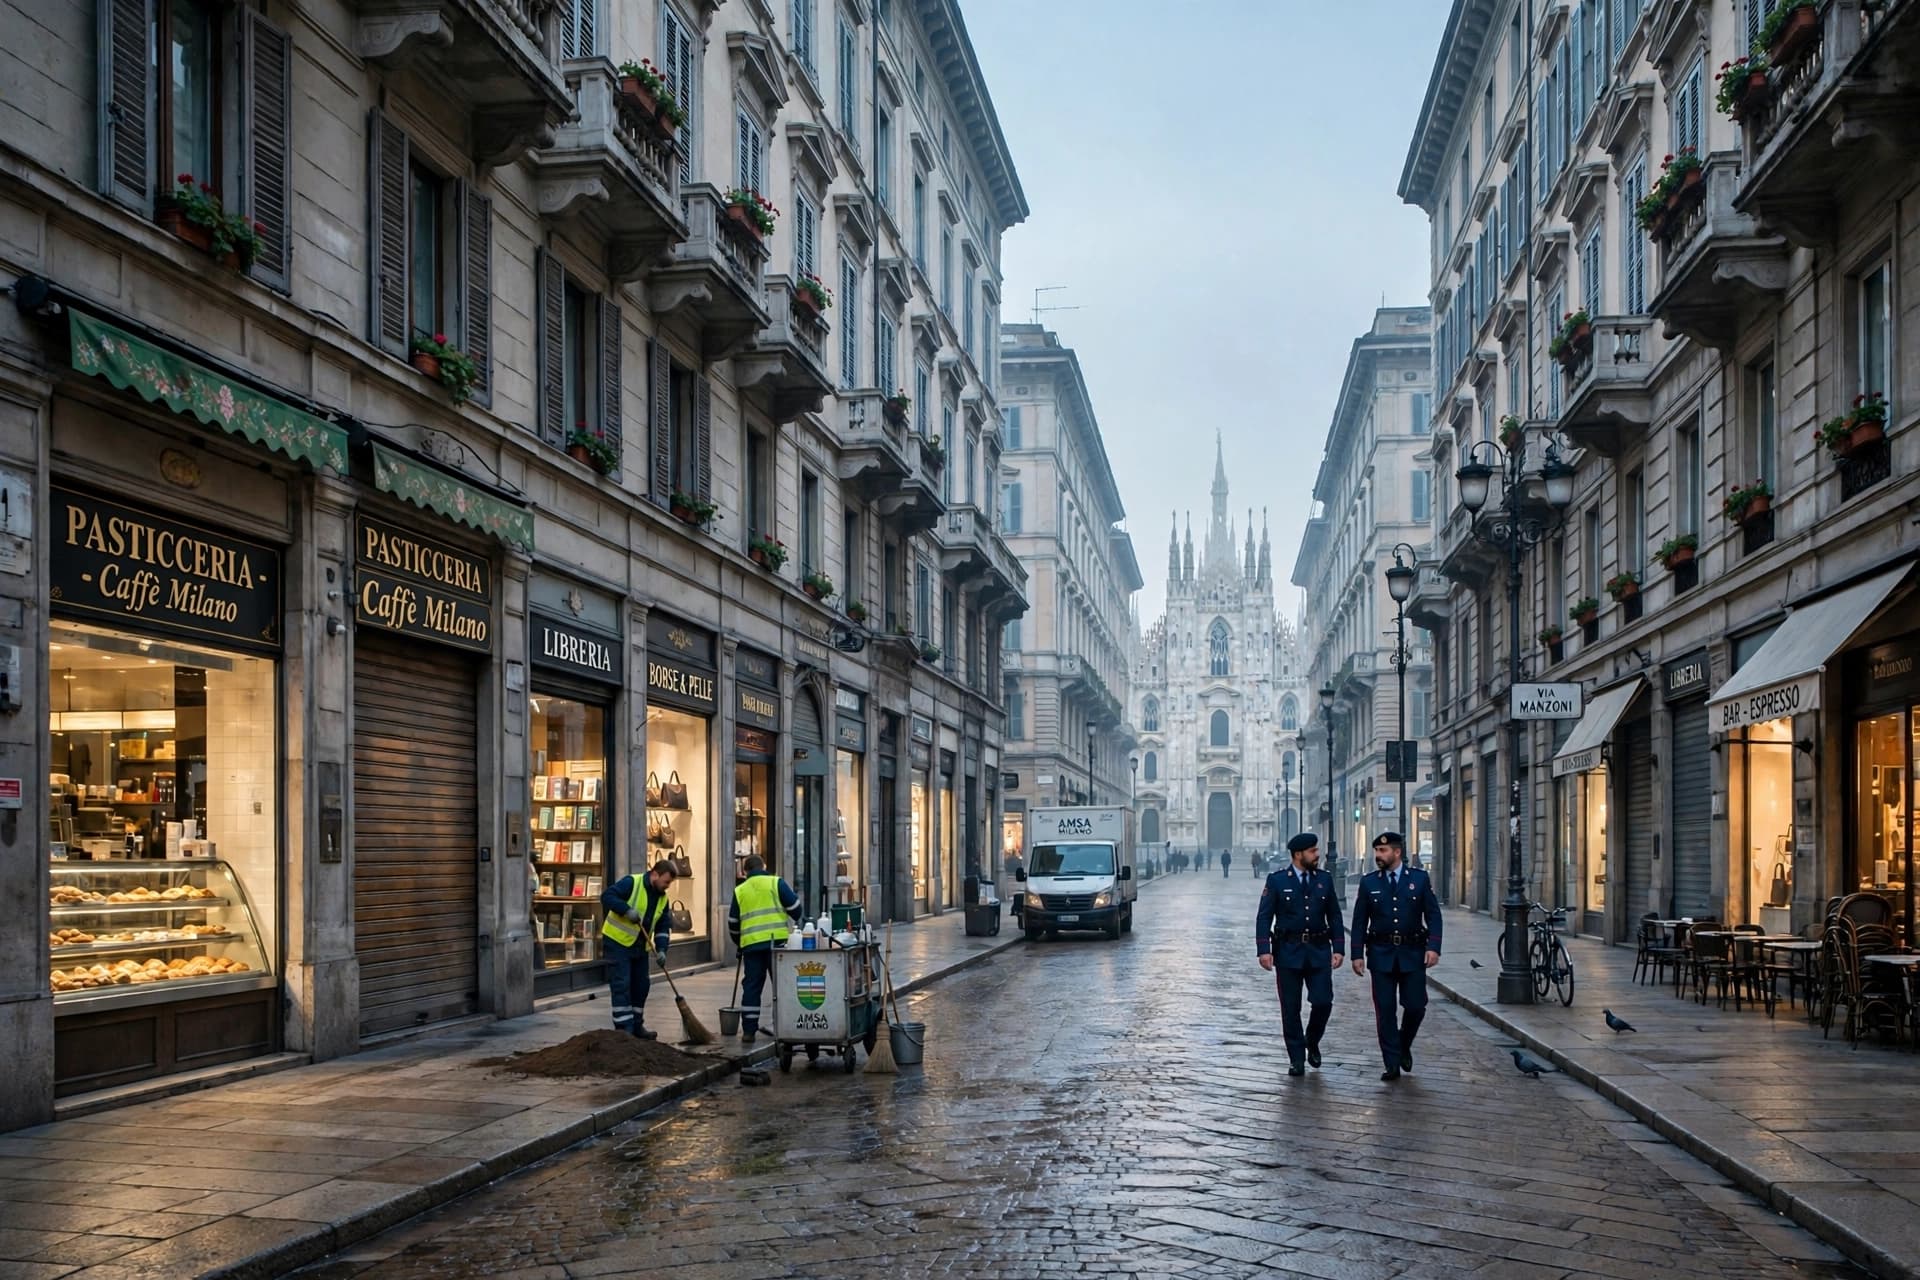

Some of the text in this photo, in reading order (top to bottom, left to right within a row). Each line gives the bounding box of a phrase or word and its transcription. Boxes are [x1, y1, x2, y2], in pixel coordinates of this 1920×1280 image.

[66, 504, 254, 590] PASTICCERIA
[365, 526, 483, 594] PASTICCERIA
[99, 563, 160, 612] Caffè
[165, 578, 238, 623] Milano
[362, 580, 487, 642] Caffè Milano
[543, 627, 612, 672] LIBRERIA
[680, 673, 687, 695] &
[689, 674, 713, 701] PELLE
[1520, 700, 1573, 713] MANZONI
[1537, 687, 1556, 698] VIA
[1723, 702, 1741, 727] BAR
[1750, 684, 1800, 720] ESPRESSO
[1058, 817, 1092, 828] AMSA
[797, 1013, 828, 1023] AMSA
